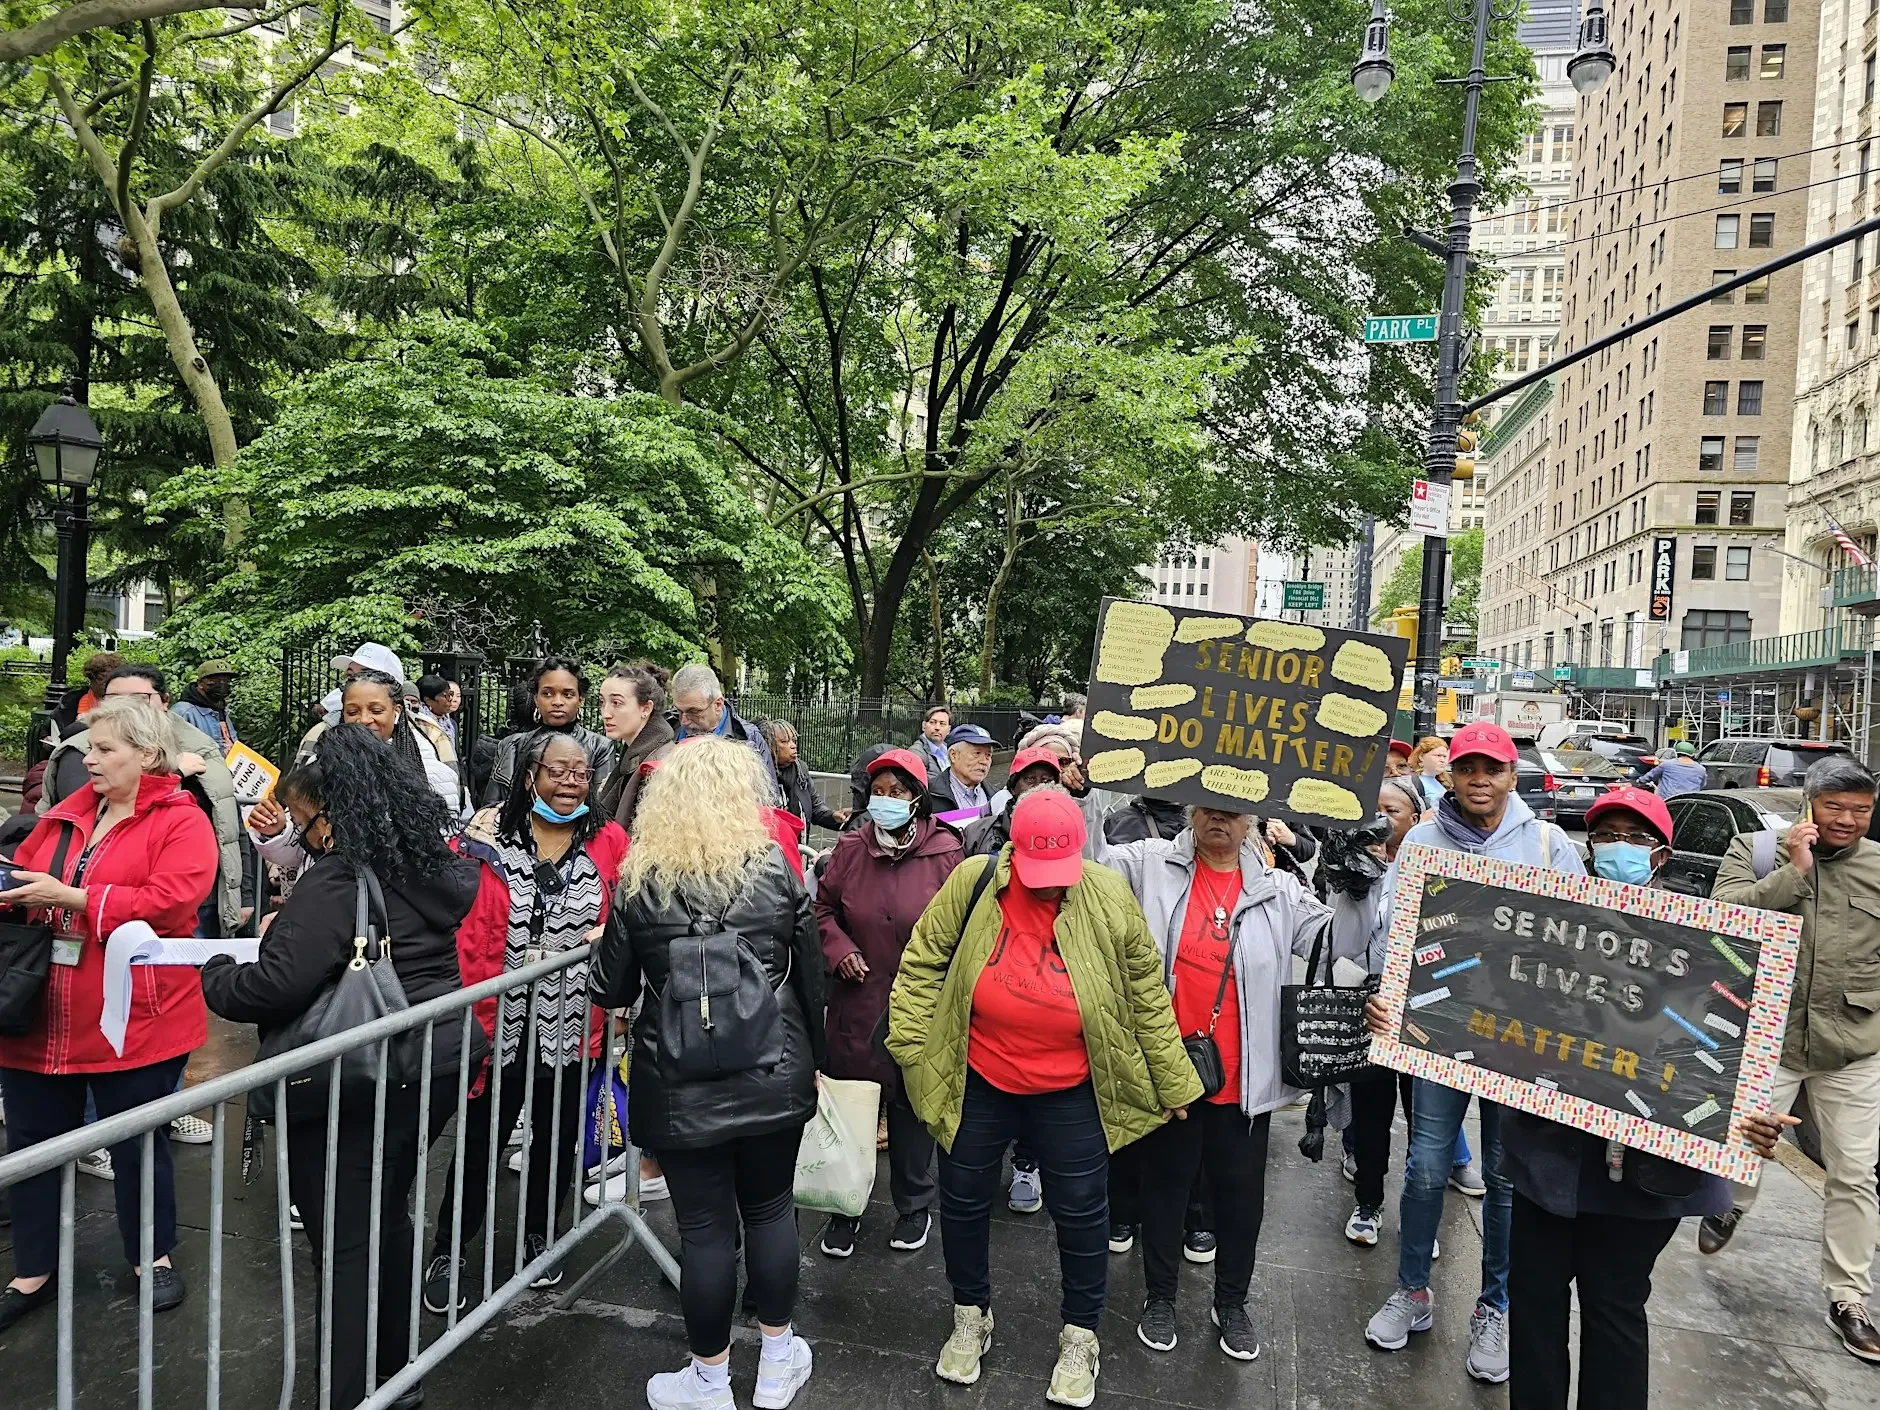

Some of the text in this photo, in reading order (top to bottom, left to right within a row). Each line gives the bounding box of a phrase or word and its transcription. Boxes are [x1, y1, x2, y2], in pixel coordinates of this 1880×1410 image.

[1370, 319, 1432, 339] PARK PL
[1656, 540, 1672, 590] PARK
[1111, 616, 1145, 625] PROGRAMS
[1108, 635, 1166, 647] CHRONIC DISEASES
[1254, 636, 1284, 645] BENEFITS
[1256, 626, 1320, 643] SOCIAL AND HEALTH
[1107, 644, 1142, 654] SUPPORTIVE
[1105, 653, 1145, 663] FRIENDSHIPS
[1340, 651, 1379, 663] COMMUNITY
[1125, 666, 1148, 674] LEVELS
[1195, 640, 1325, 688] SENIOR
[1337, 660, 1368, 671] SERVICES
[1102, 672, 1140, 682] DEPRESSION
[1349, 673, 1385, 686] PROGRAMS
[1135, 689, 1189, 697] TRANSPORTATION
[1201, 686, 1309, 733] LIVES
[1357, 709, 1383, 721] FITNESS
[1101, 719, 1124, 728] AGEISM
[1327, 709, 1375, 728] AND WELLNESS
[1324, 718, 1360, 733] PROGRAMS
[1157, 713, 1380, 783] DO MATTER!
[237, 763, 256, 788] FUND
[1092, 768, 1132, 779] TECHNOLOGY
[1150, 764, 1195, 775] LOWER STRESS
[1206, 768, 1228, 778] ARE
[246, 775, 266, 798] Aging
[1205, 779, 1265, 797] THERE YET?
[1299, 784, 1328, 792] FUNDING
[1297, 793, 1335, 803] RESOURCES
[1295, 802, 1358, 815] QUALITY PROGRAMS
[1422, 912, 1458, 932] HOPE
[1493, 906, 1691, 977] SENIORS
[1181, 944, 1206, 958] WILL
[1419, 949, 1442, 964] JOY
[1712, 937, 1753, 976] FABULOUS
[994, 971, 1015, 985] WE
[1018, 977, 1046, 993] WILL
[1509, 954, 1644, 1013] LIVES
[1712, 981, 1748, 1011] Experience
